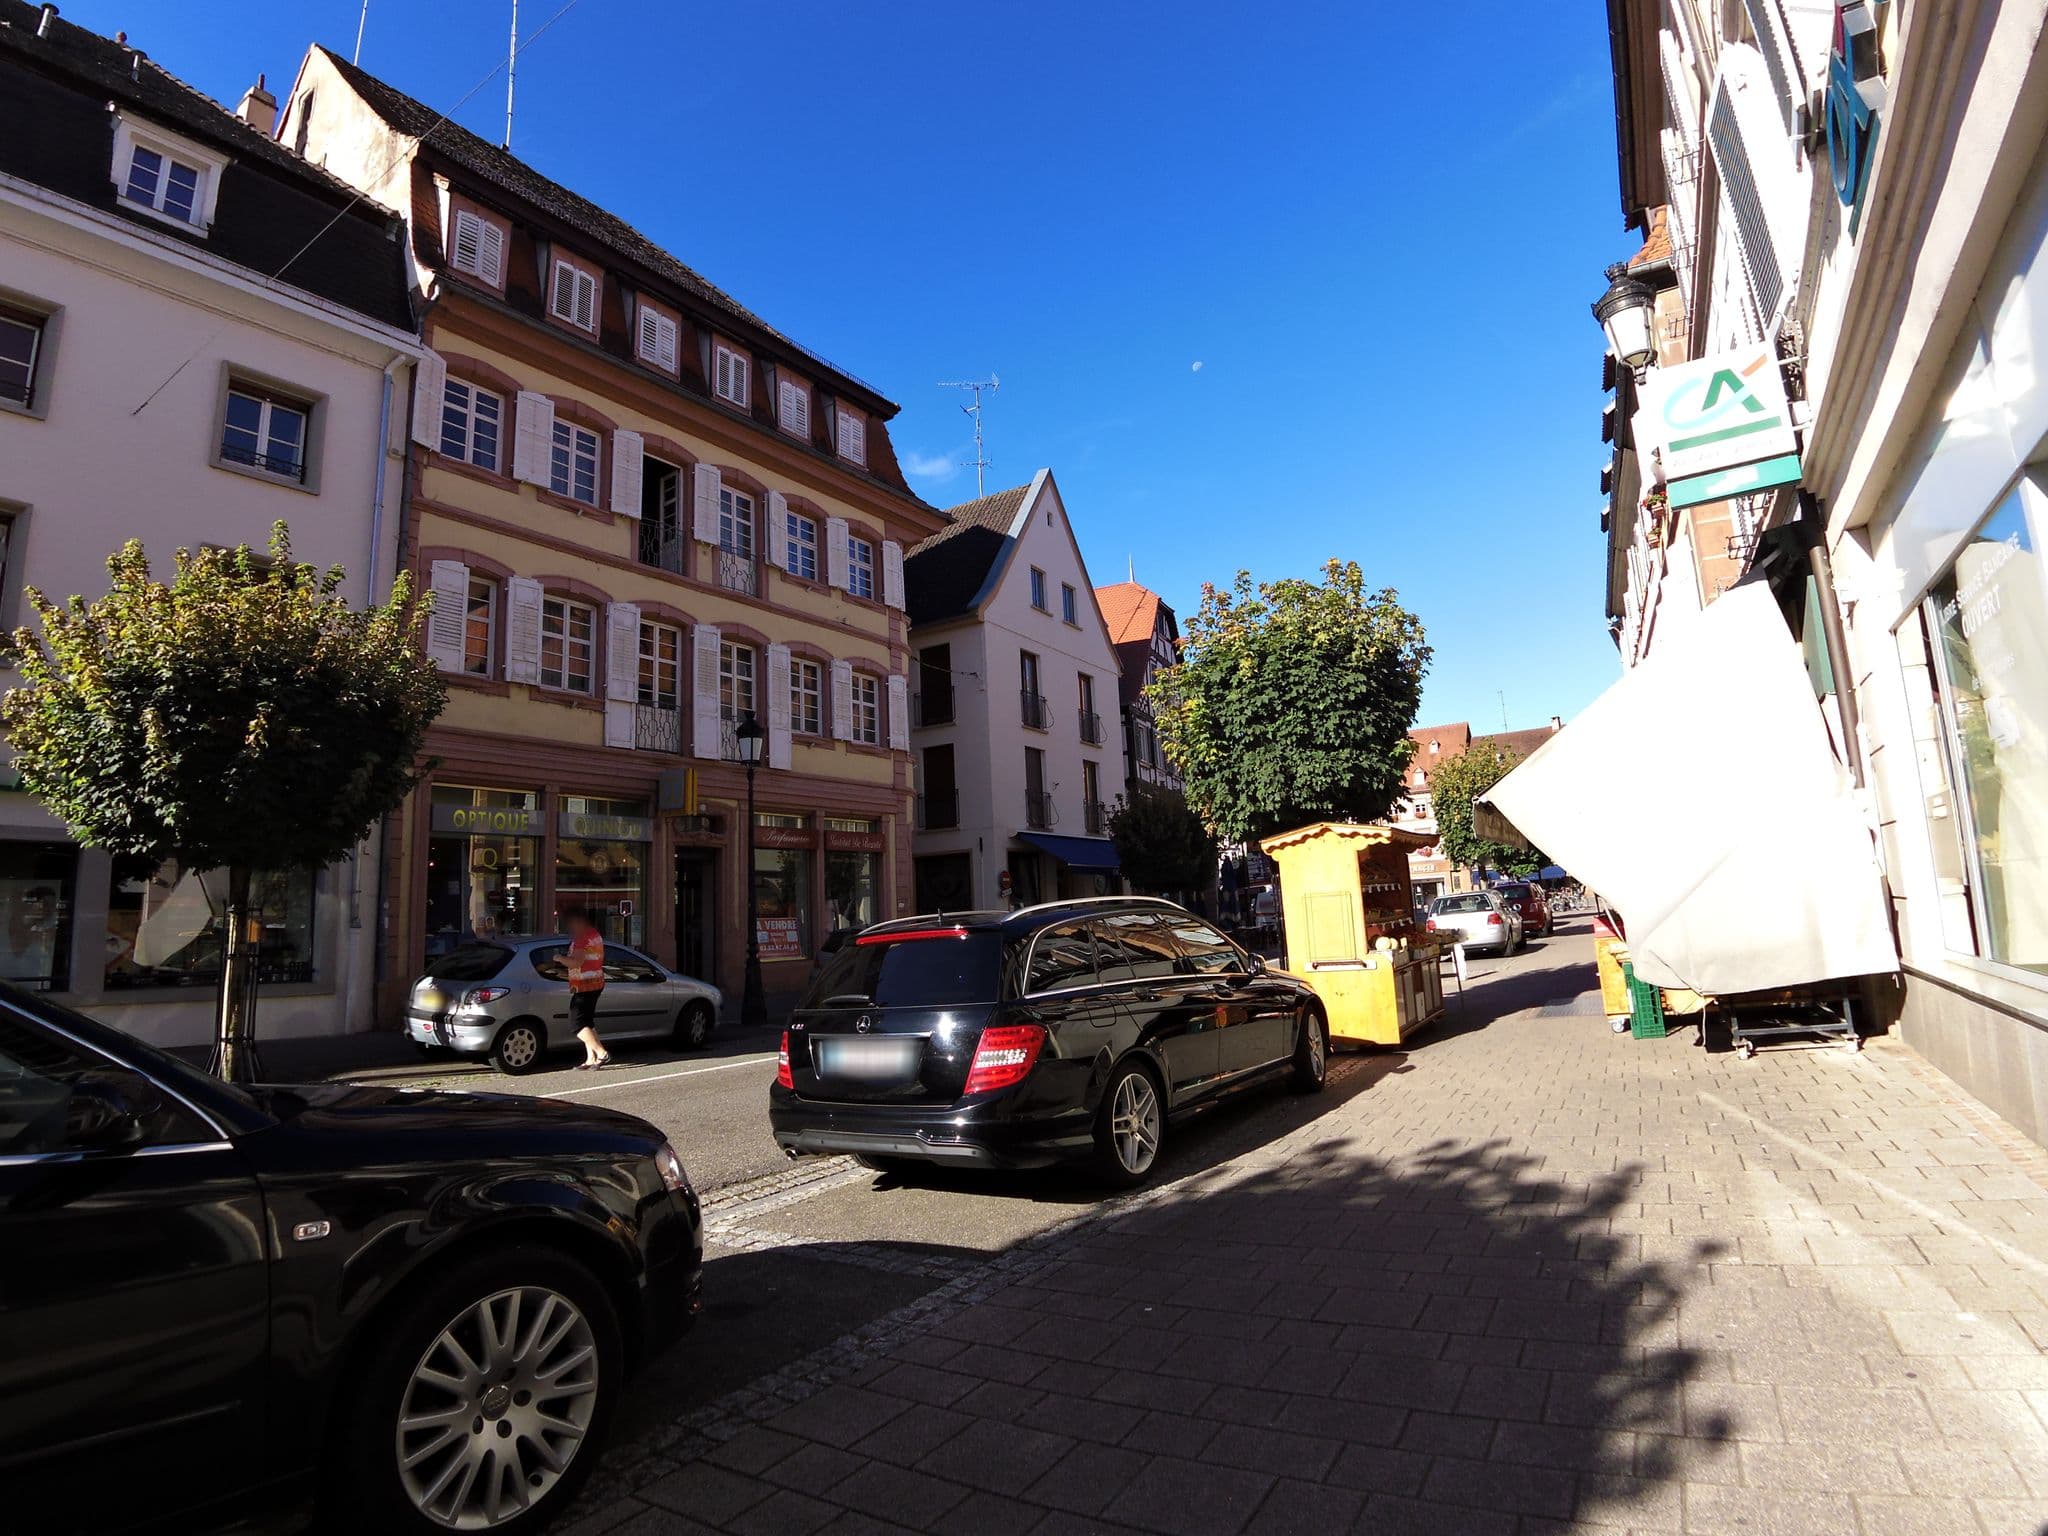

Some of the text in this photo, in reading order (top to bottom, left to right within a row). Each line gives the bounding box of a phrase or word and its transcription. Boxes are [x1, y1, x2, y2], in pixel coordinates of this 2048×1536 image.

[1962, 583, 2001, 638] OUVERT
[452, 809, 529, 832] OPTIQUE
[764, 919, 797, 930] VENDRE
